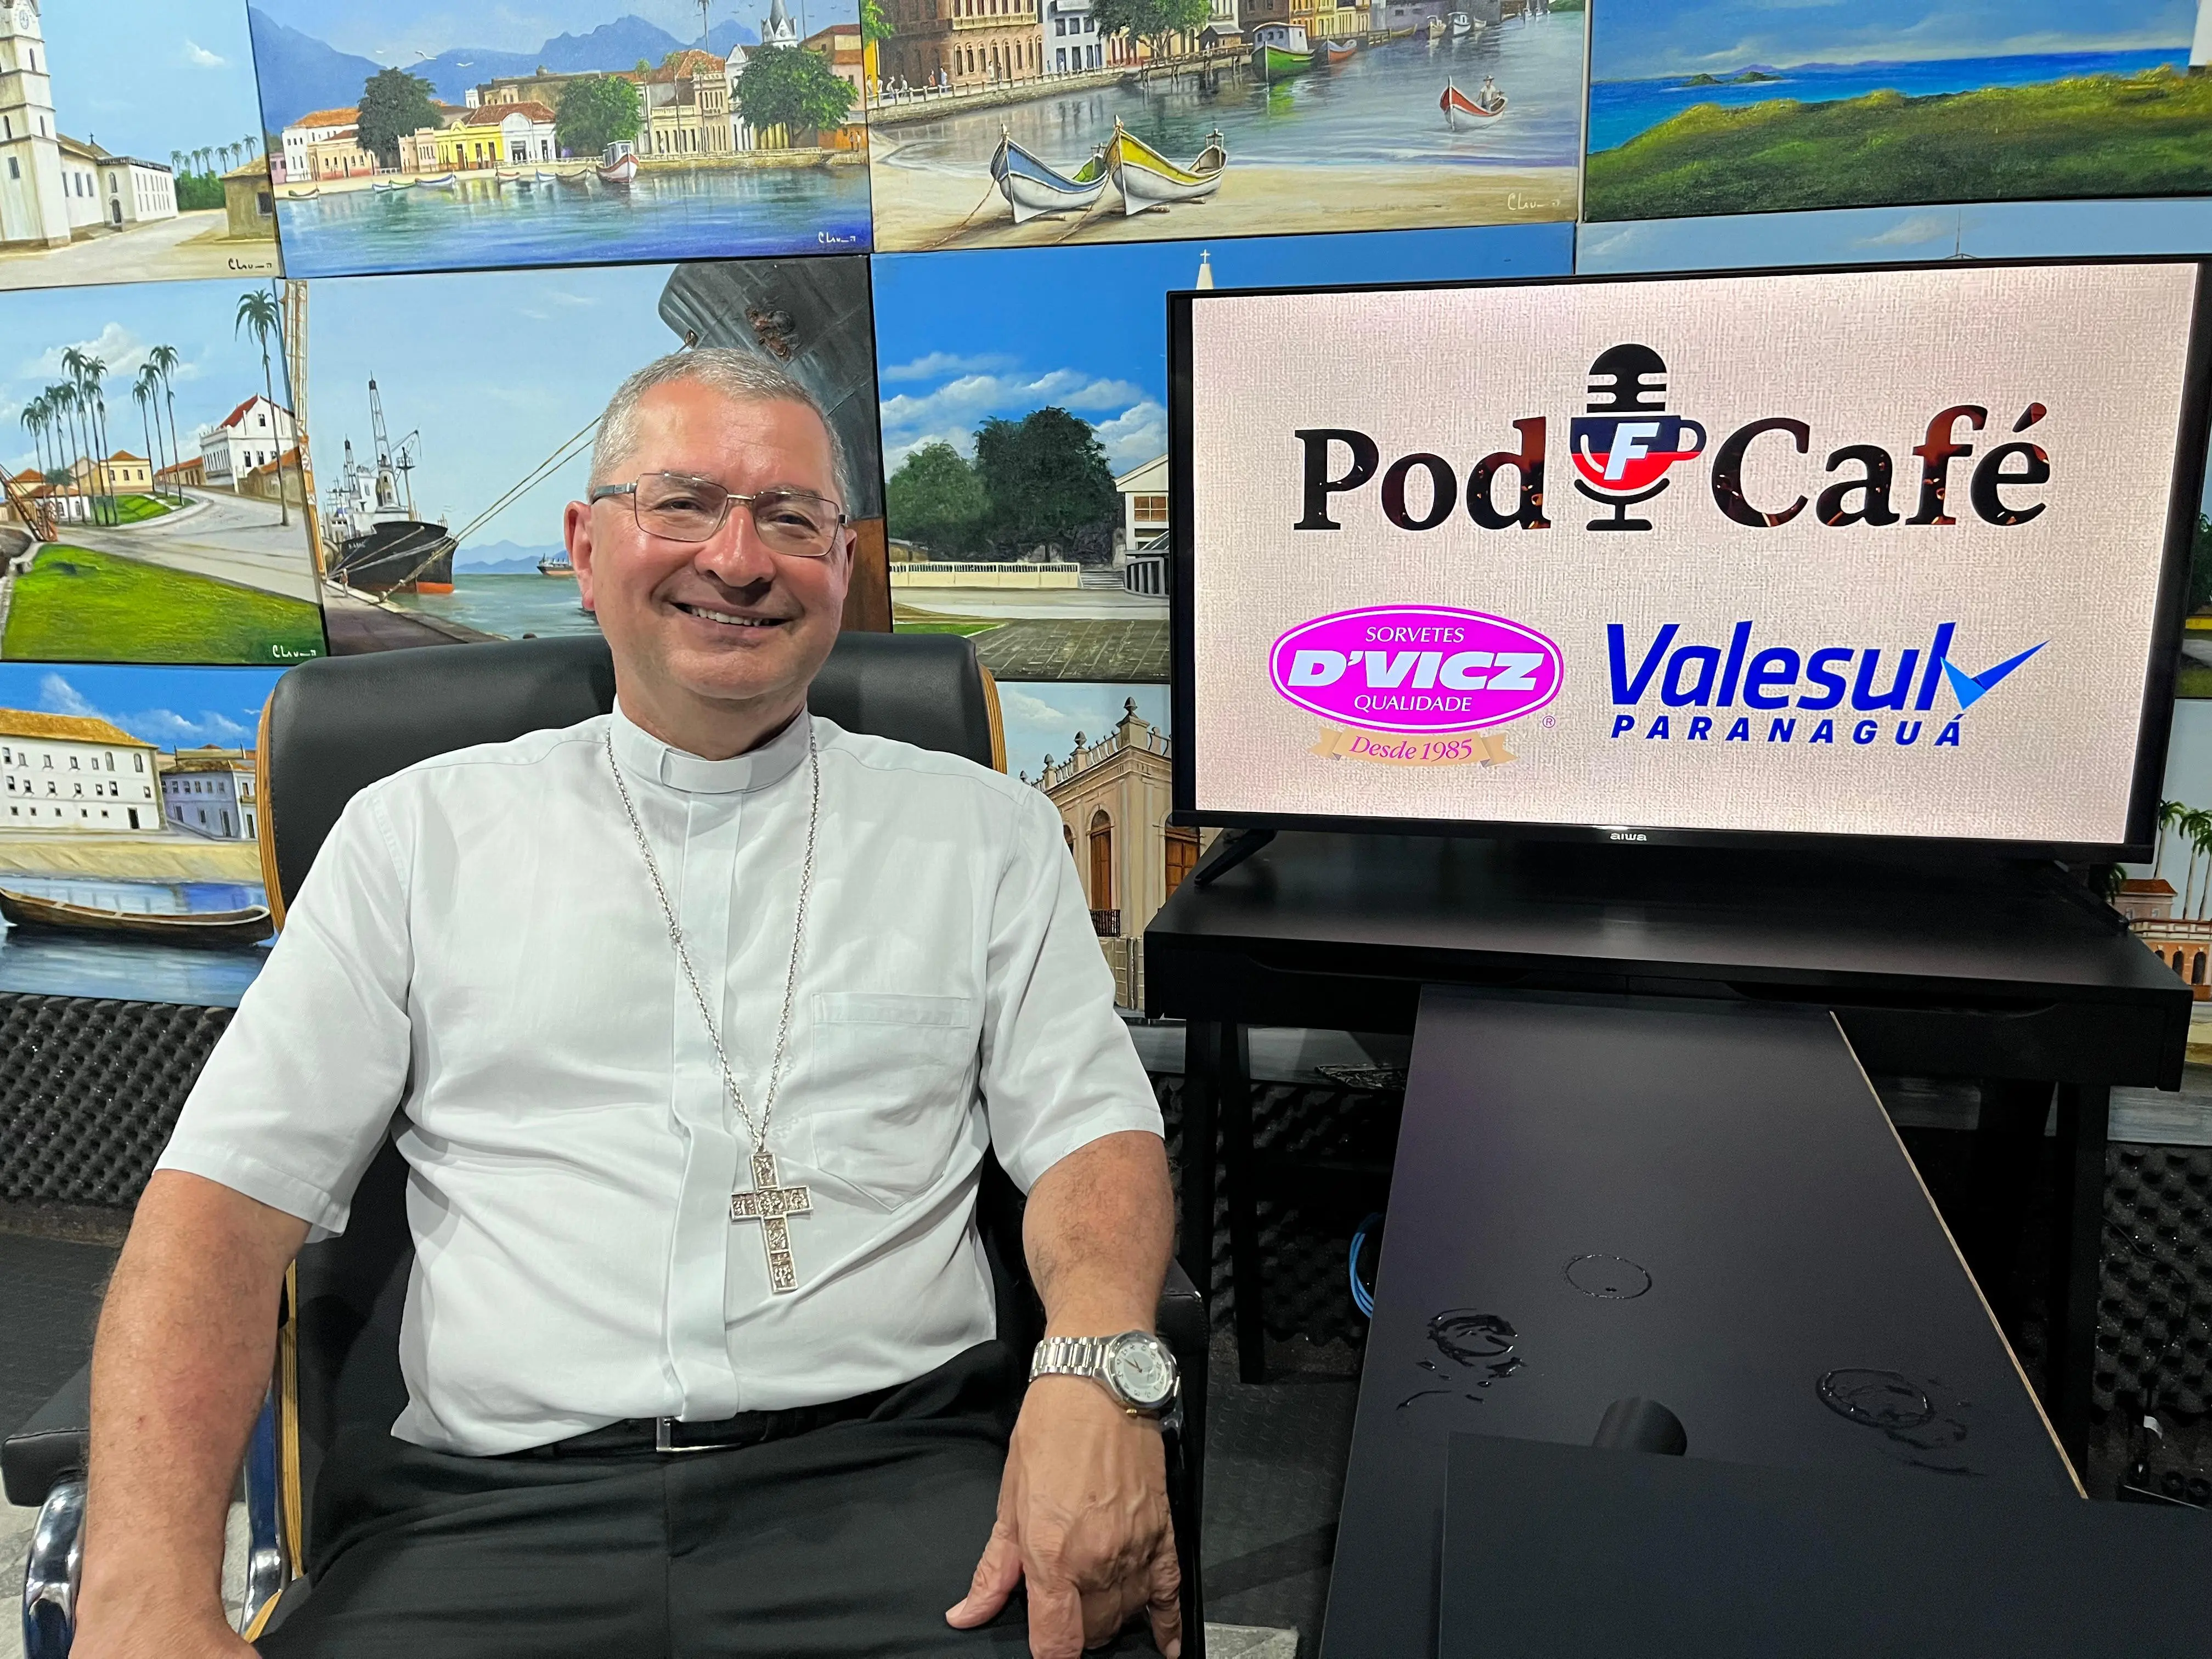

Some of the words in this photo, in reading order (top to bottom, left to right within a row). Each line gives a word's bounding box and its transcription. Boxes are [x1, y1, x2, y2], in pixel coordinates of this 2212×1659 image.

[1293, 415, 1552, 532] Pod
[1711, 402, 2051, 528] Café
[1365, 626, 1465, 644] SORVETES
[1287, 650, 1545, 691] D'VICZ
[1606, 621, 1957, 712] Valesul
[1353, 694, 1472, 713] QUALIDADE
[1611, 713, 1966, 747] PARANAGUÁ
[1348, 735, 1417, 760] Desde
[1419, 738, 1472, 763] 1985
[1610, 833, 1647, 841] aiwa
